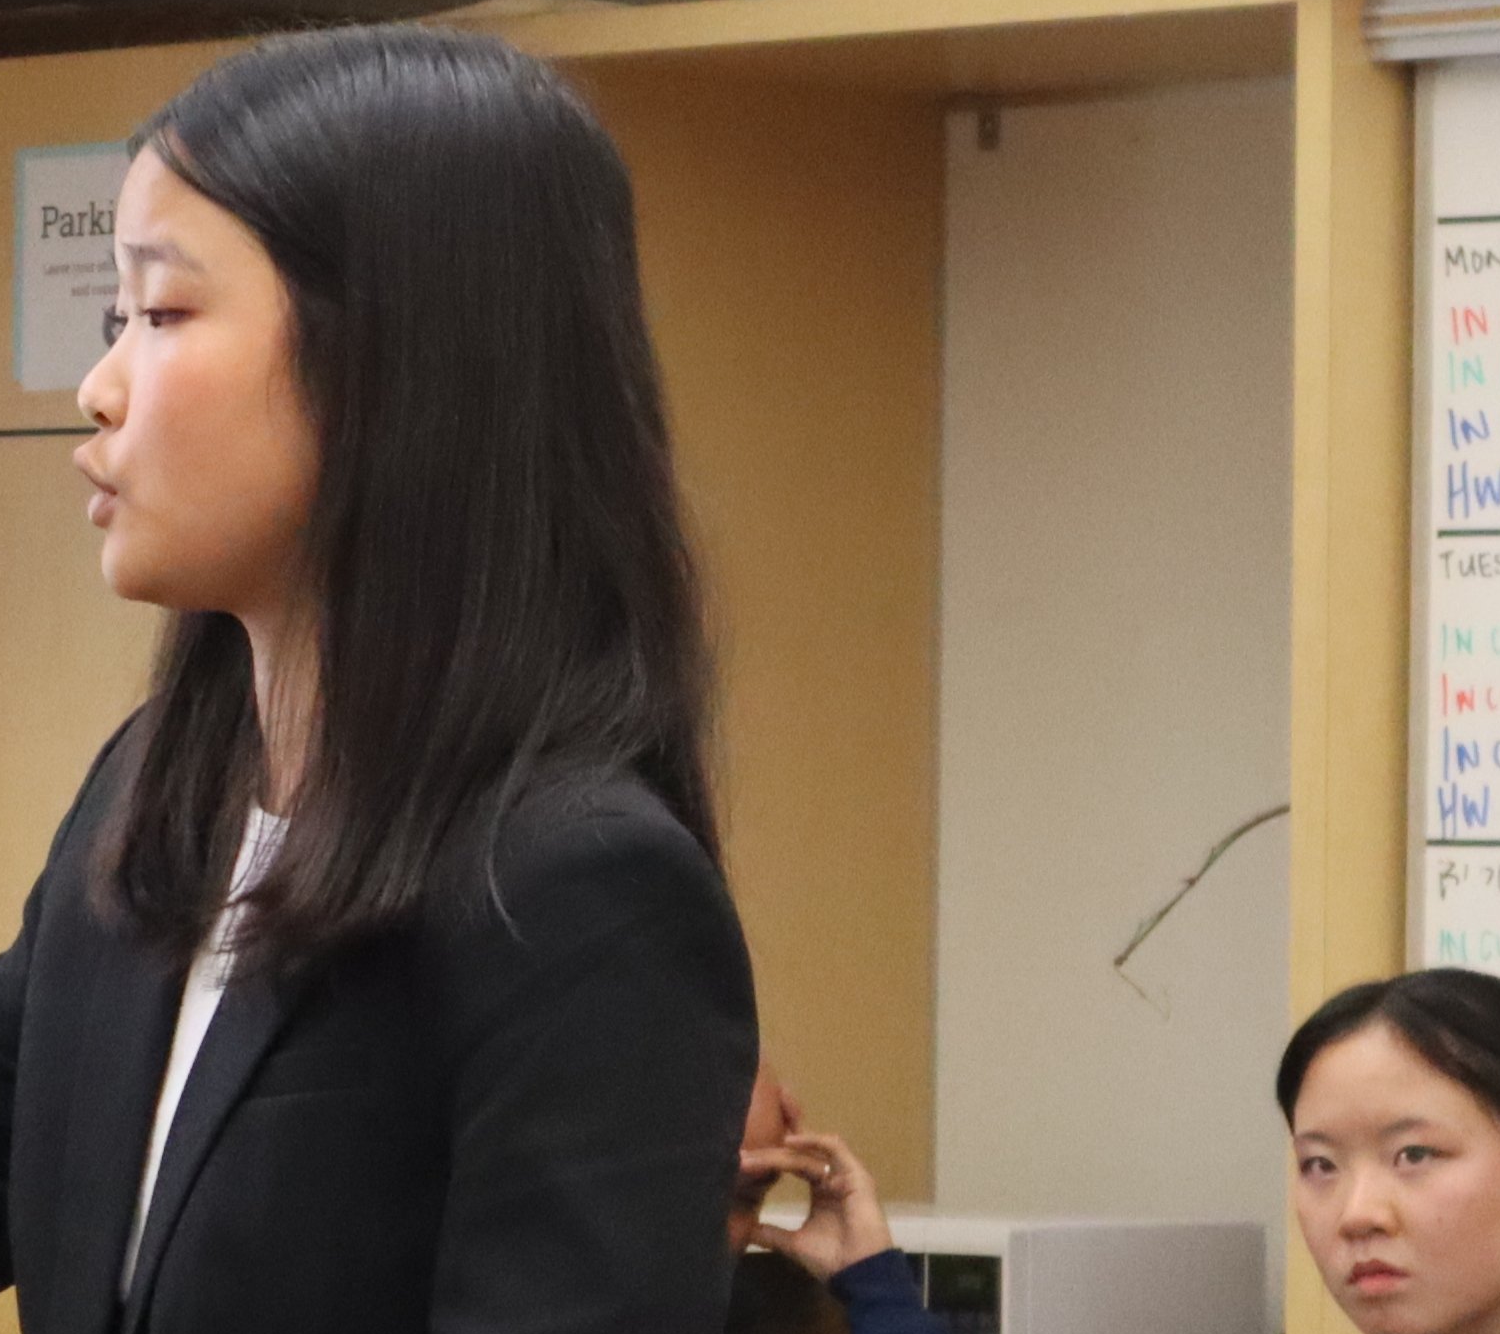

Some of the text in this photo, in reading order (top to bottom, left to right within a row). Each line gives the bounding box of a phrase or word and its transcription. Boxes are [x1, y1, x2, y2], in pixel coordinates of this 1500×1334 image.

[41, 199, 116, 239] Parki
[1451, 305, 1488, 346] IN
[1448, 408, 1490, 451] IN
[1437, 782, 1490, 840] HW
